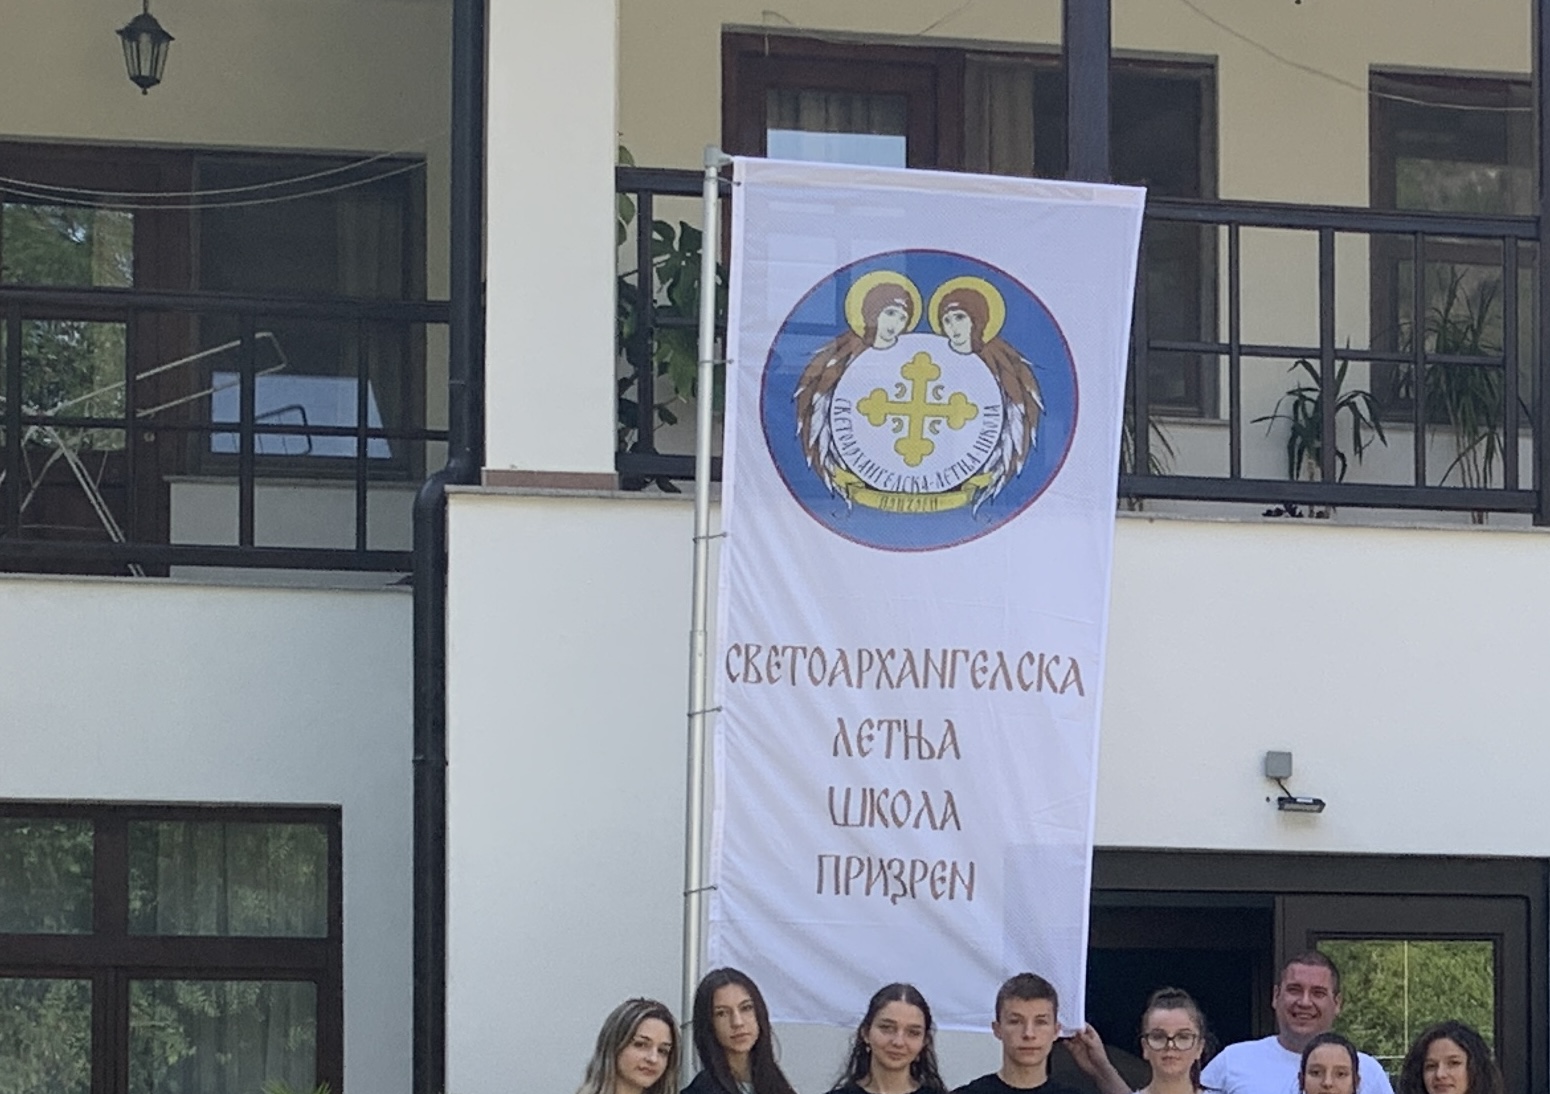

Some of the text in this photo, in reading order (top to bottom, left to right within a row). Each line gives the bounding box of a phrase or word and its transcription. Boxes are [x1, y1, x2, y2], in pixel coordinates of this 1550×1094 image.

[725, 643, 1085, 697] СВЕТОАРХАНГЕЛСКА
[832, 717, 961, 761] ЛЕТЊА
[828, 786, 961, 831] ШКОЛА
[816, 854, 975, 906] ПРИЗРЕН
